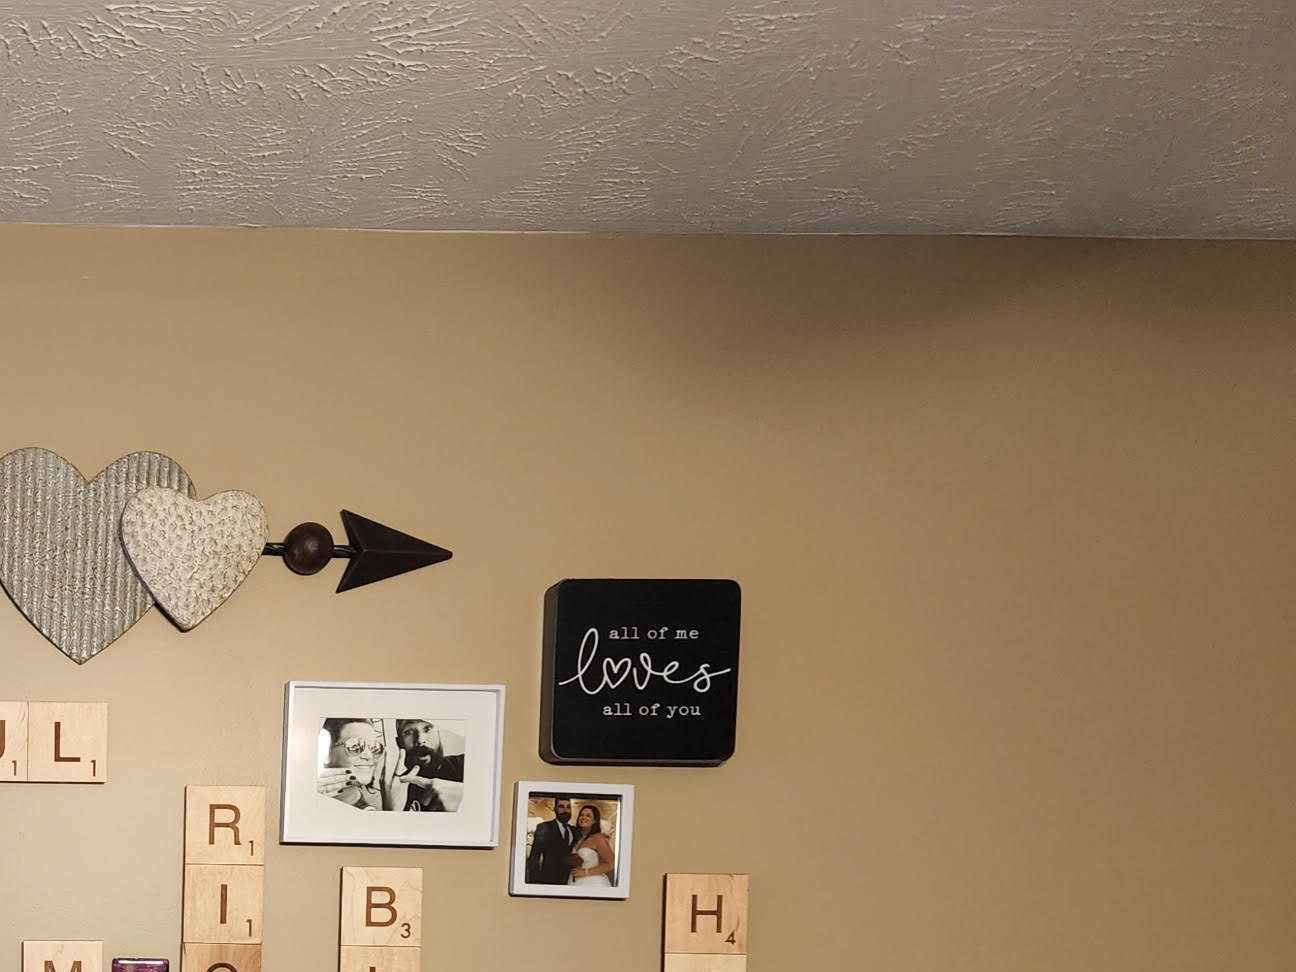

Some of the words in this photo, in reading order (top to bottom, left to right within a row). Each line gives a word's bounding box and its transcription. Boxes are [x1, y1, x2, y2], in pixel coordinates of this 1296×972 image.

[609, 626, 640, 639] all
[647, 626, 668, 639] of
[674, 628, 699, 639] me
[603, 703, 632, 716] all
[638, 703, 660, 716] of
[666, 705, 701, 719] you
